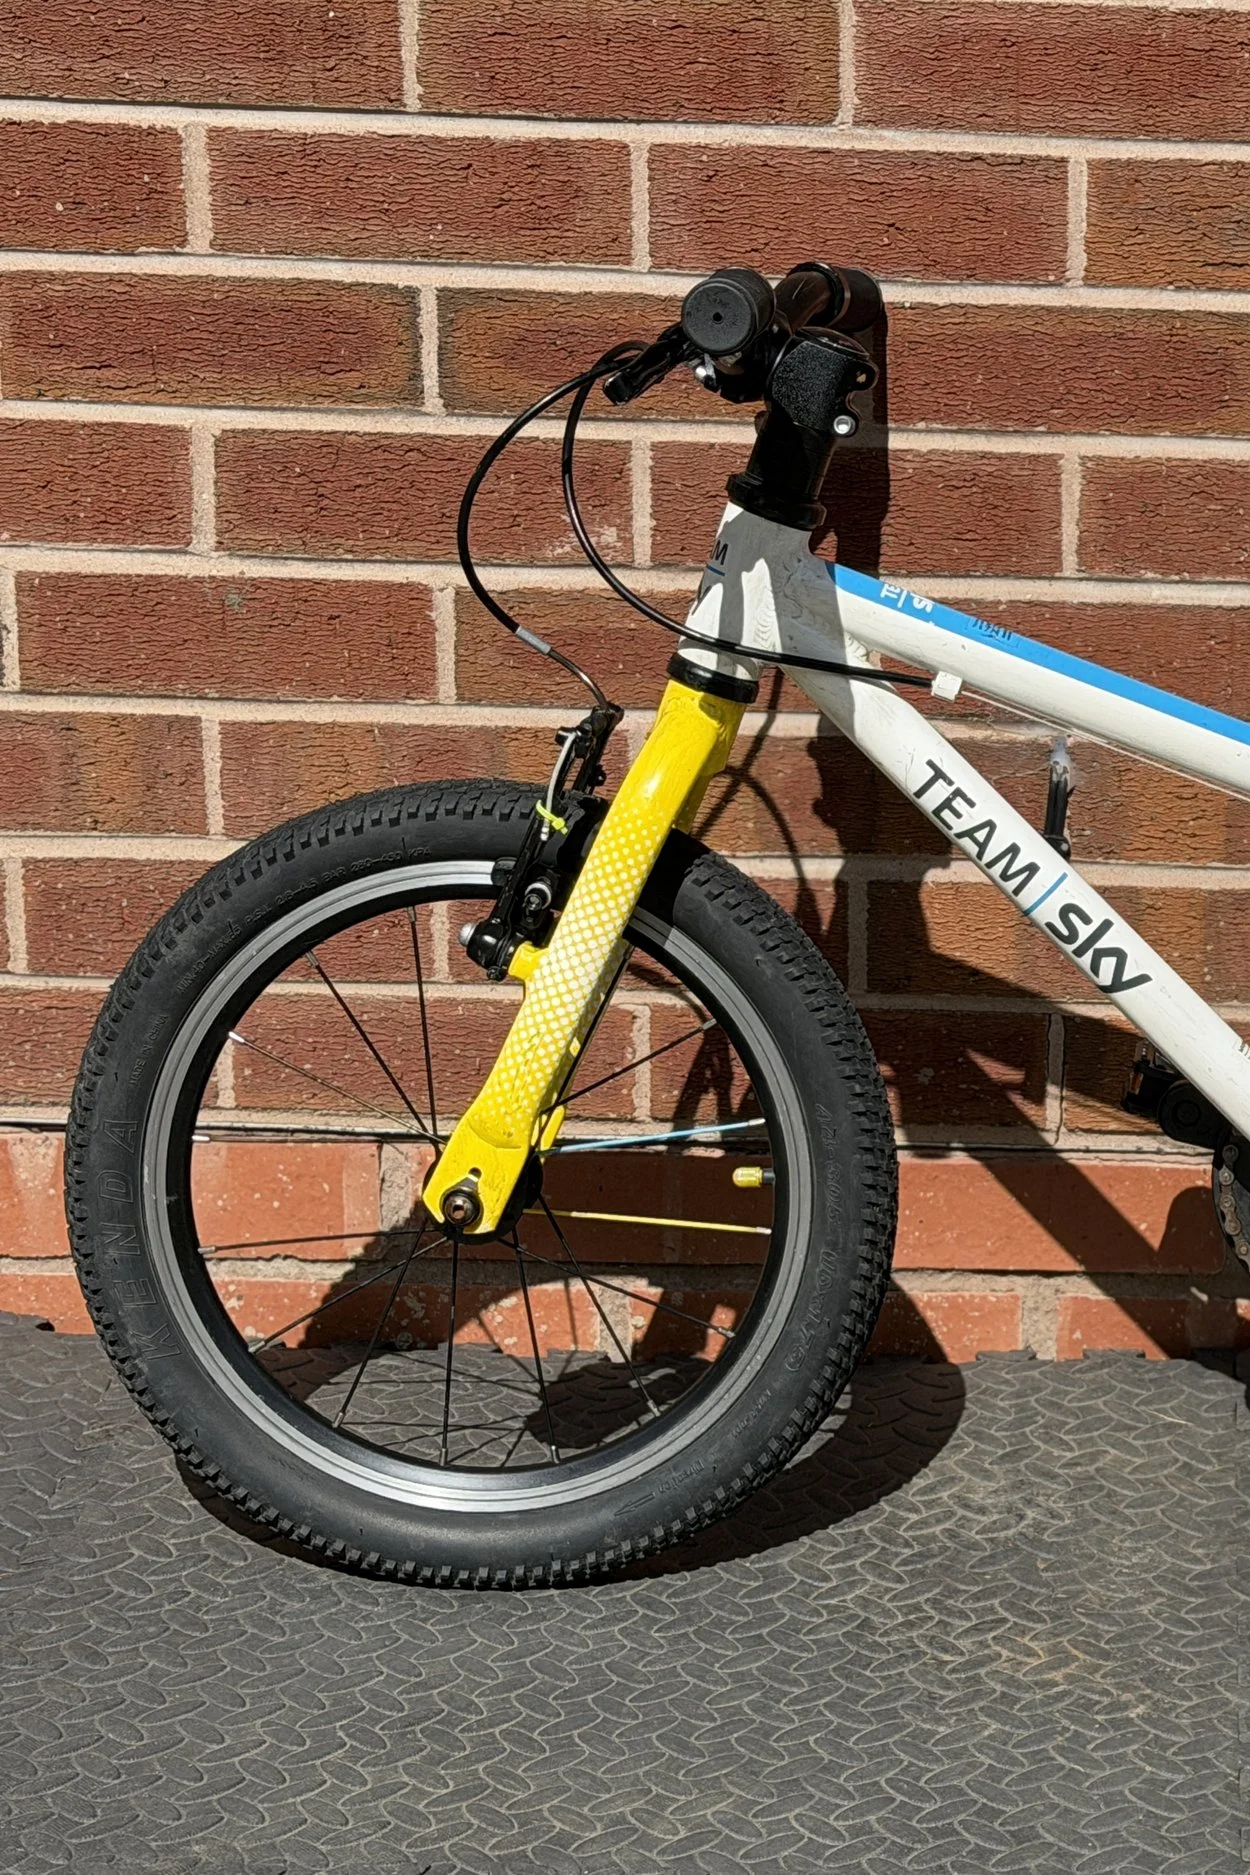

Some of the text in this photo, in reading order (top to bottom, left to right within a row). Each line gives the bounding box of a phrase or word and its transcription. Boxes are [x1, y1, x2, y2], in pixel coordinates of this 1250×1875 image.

[912, 758, 1153, 994] TEAM sky
[150, 1013, 168, 1041] CHINA
[100, 1119, 182, 1365] KENDA
